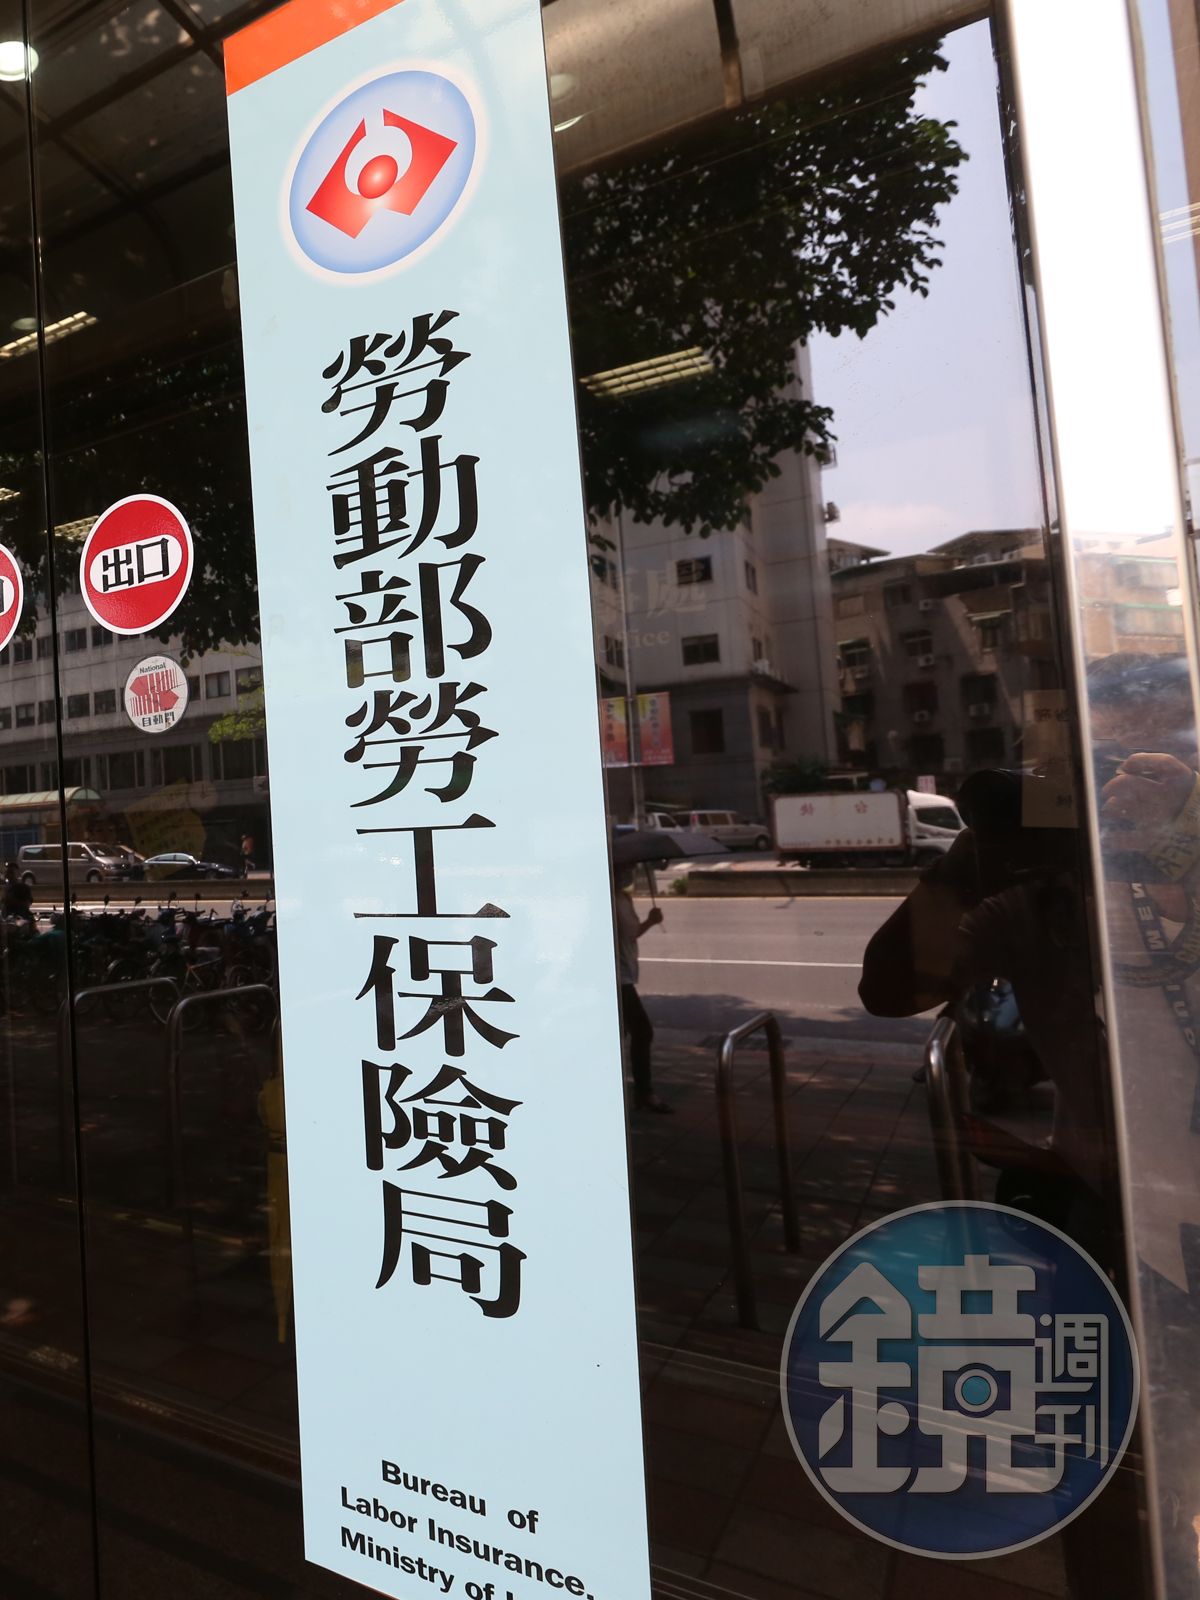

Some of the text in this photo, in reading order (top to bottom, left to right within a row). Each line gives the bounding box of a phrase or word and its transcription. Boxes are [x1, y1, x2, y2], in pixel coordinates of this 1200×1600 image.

[102, 537, 169, 592] 出口
[140, 662, 166, 674] National
[142, 711, 175, 727] 自動門
[322, 310, 527, 1318] 勞動部勞工保險局
[382, 1459, 539, 1534] Bureau of
[341, 1486, 594, 1600] Labor Insurance,
[341, 1526, 455, 1593] Ministry
